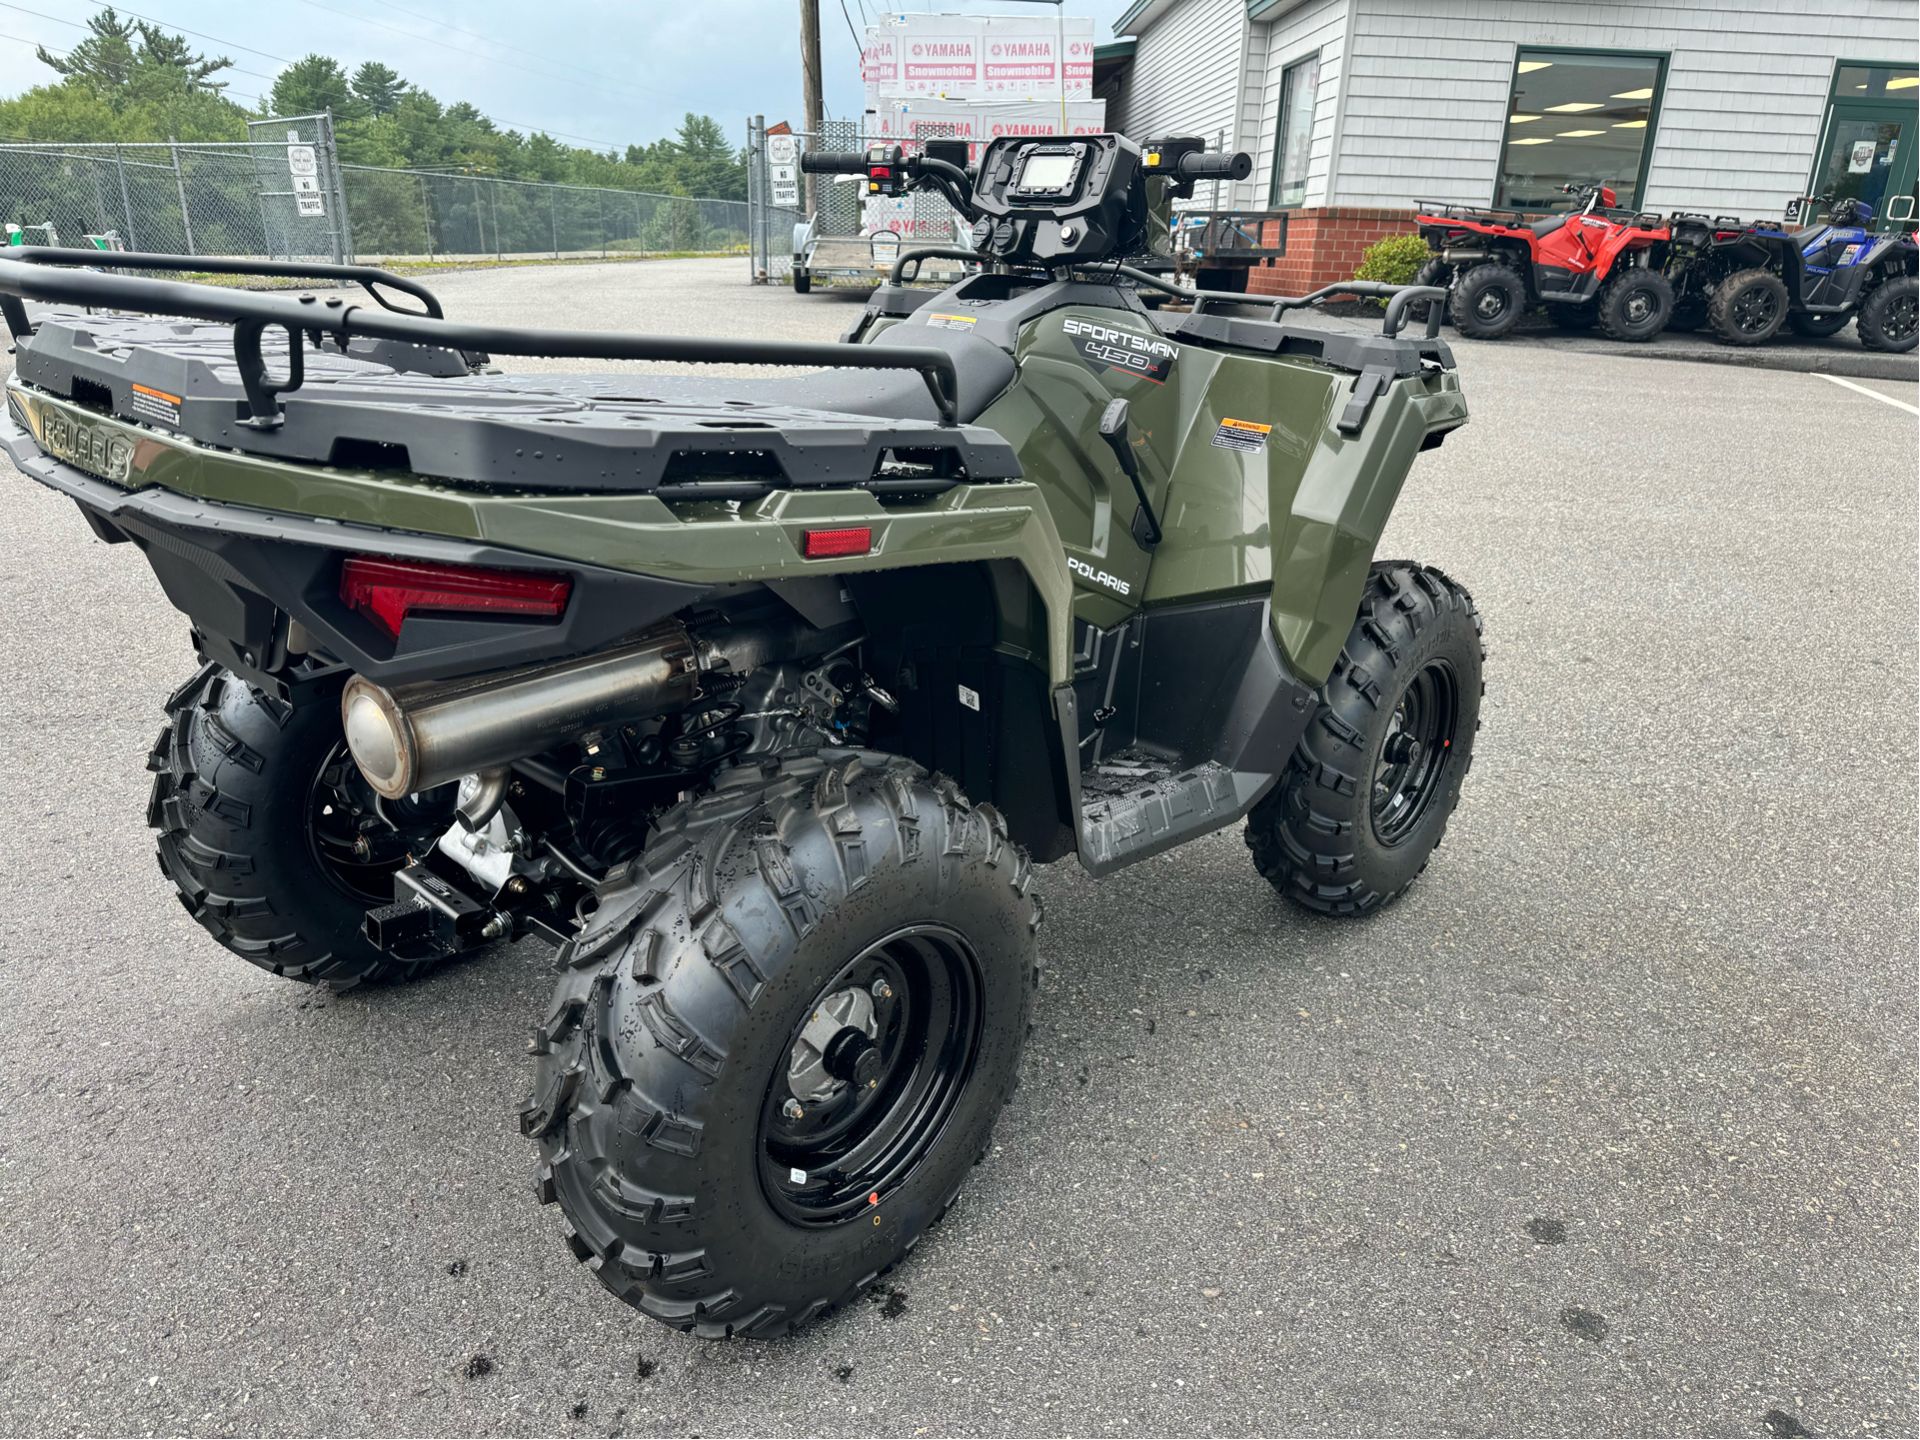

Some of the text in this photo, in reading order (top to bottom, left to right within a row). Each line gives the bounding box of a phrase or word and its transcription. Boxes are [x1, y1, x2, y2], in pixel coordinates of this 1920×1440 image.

[924, 43, 972, 57] YAMAHA
[1003, 43, 1051, 56] YAMAHA
[908, 65, 973, 77] Snowmobile
[987, 65, 1051, 76] Snowmobile
[1006, 124, 1054, 136] YAMAHA
[780, 170, 787, 179] NO
[302, 181, 310, 190] NO
[774, 180, 795, 188] THROUGH
[298, 191, 319, 199] THROUGH
[776, 190, 795, 199] TRAFFIC
[300, 201, 320, 210] TRAFFIC
[1062, 319, 1180, 360] SPORTSMAN
[1085, 341, 1150, 370] 450
[1067, 556, 1131, 596] POLARIS
